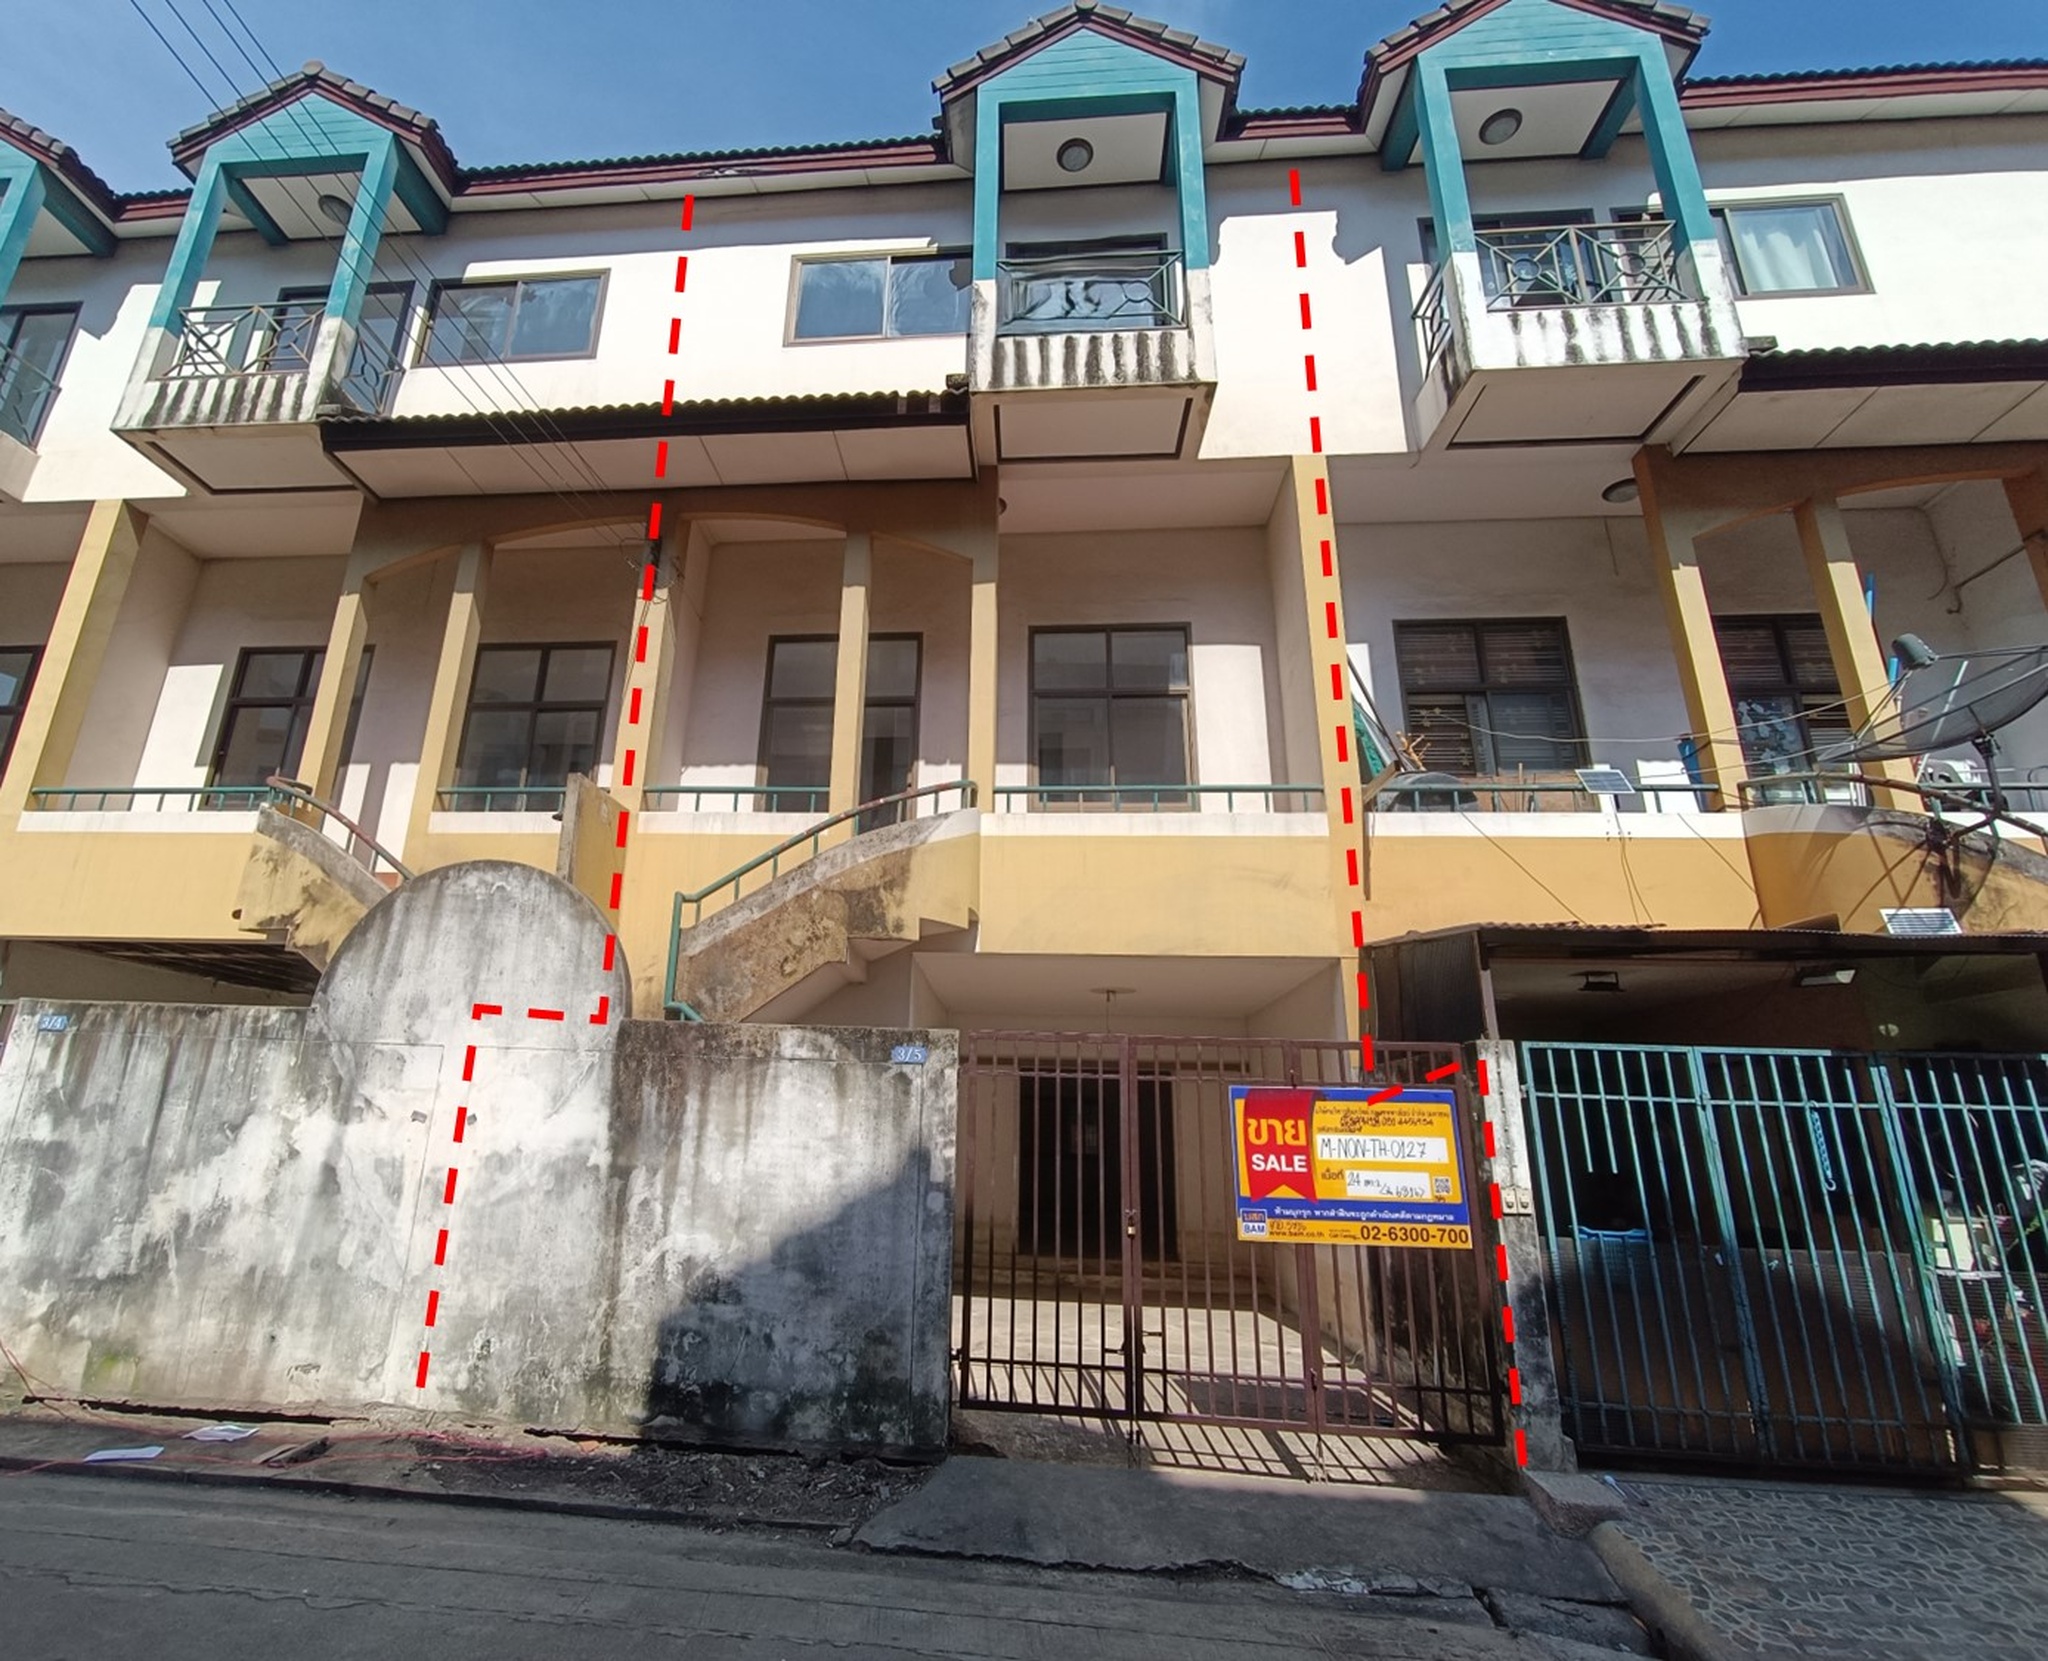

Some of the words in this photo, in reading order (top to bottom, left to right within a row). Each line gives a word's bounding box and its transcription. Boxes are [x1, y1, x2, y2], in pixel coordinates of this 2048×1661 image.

[897, 1048, 922, 1061] 3/5
[1247, 1118, 1307, 1146] ขาย
[1252, 1153, 1308, 1172] SALE
[1347, 1172, 1361, 1187] 24
[1244, 1223, 1265, 1234] BAM
[1360, 1225, 1468, 1244] 02-6300-700
